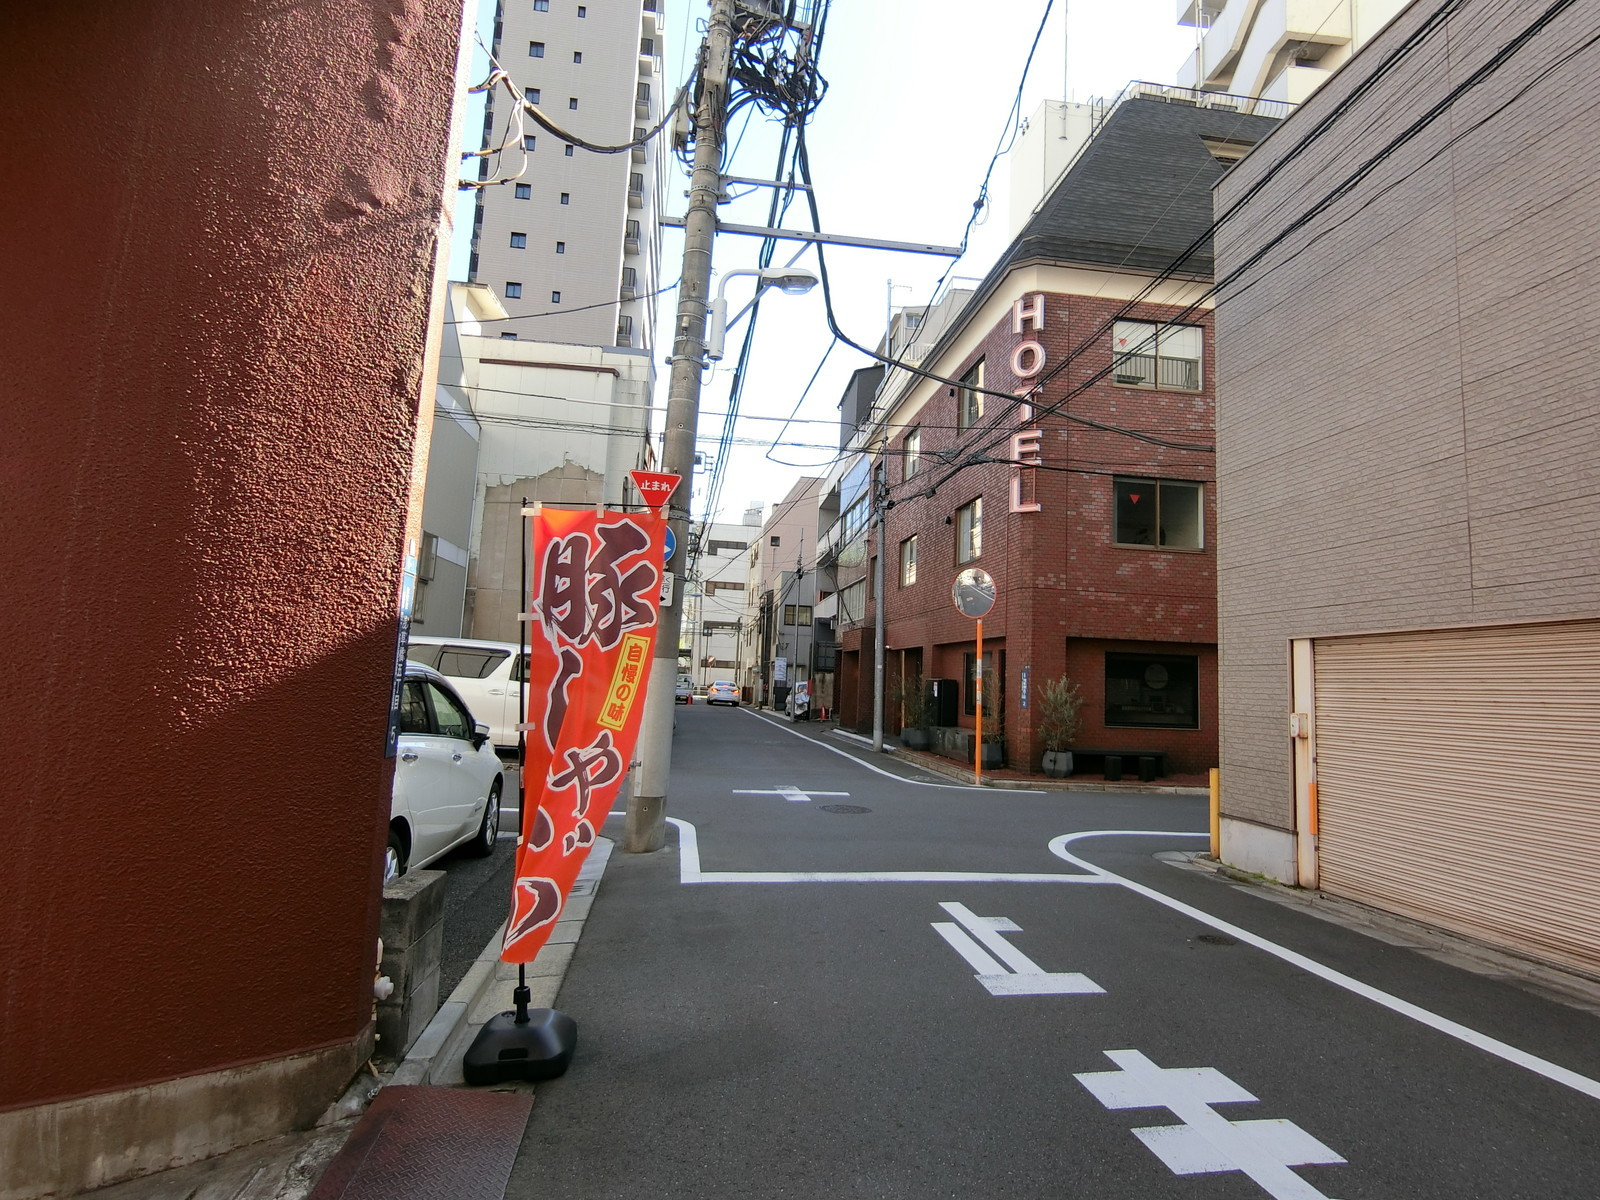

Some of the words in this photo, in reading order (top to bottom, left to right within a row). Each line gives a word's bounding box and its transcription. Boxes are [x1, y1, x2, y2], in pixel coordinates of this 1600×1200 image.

[1009, 294, 1046, 513] HOTEL
[640, 480, 671, 492] 止まれ
[607, 643, 643, 722] 自慢の味
